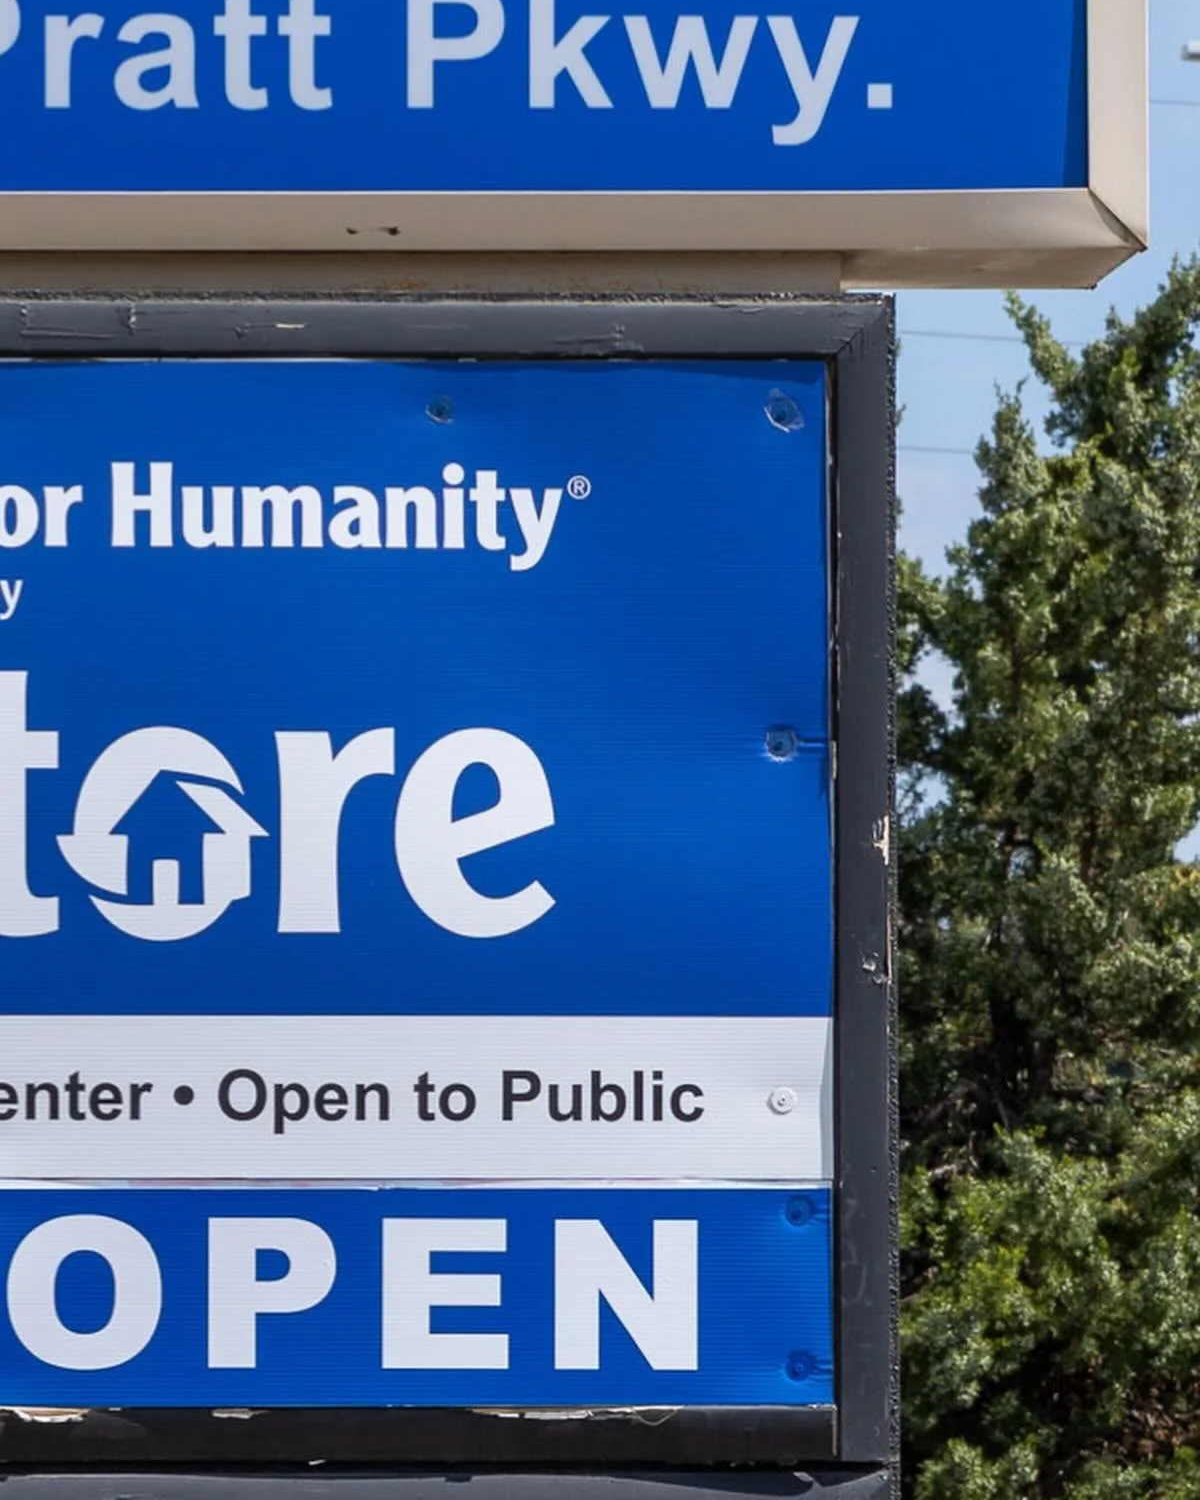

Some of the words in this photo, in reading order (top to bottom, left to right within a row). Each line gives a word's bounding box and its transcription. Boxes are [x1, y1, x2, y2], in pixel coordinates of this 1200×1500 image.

[217, 1068, 390, 1135] Open
[413, 1071, 477, 1122] to
[502, 1070, 705, 1123] Public
[6, 1214, 698, 1371] OPEN
